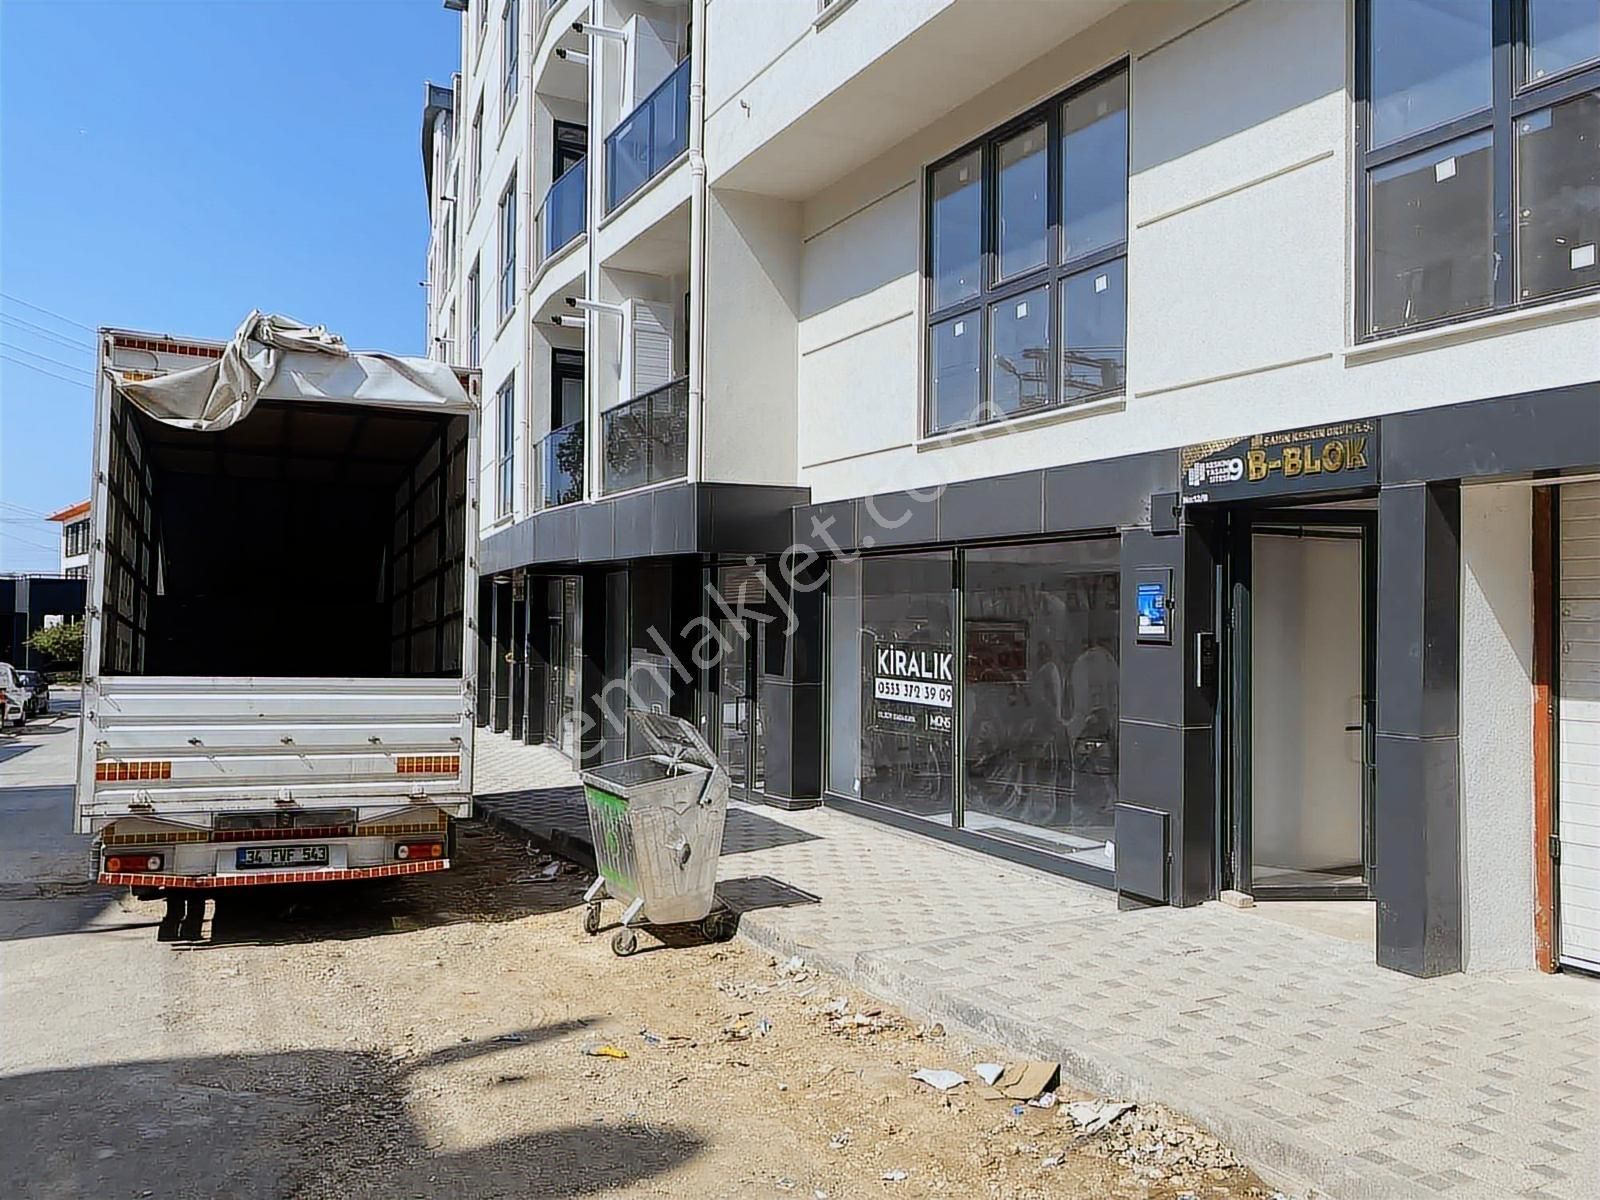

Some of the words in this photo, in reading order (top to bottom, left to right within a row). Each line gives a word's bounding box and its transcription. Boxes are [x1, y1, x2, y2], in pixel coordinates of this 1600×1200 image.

[1229, 457, 1244, 481] 9
[1247, 436, 1369, 481] B-BLOK
[877, 644, 953, 681] KİRALIK
[878, 681, 900, 696] 0533
[903, 684, 921, 699] 372
[924, 686, 937, 701] 39
[939, 688, 952, 703] 09
[246, 850, 262, 864] 34
[271, 848, 295, 862] FVF
[303, 847, 326, 861] 543
